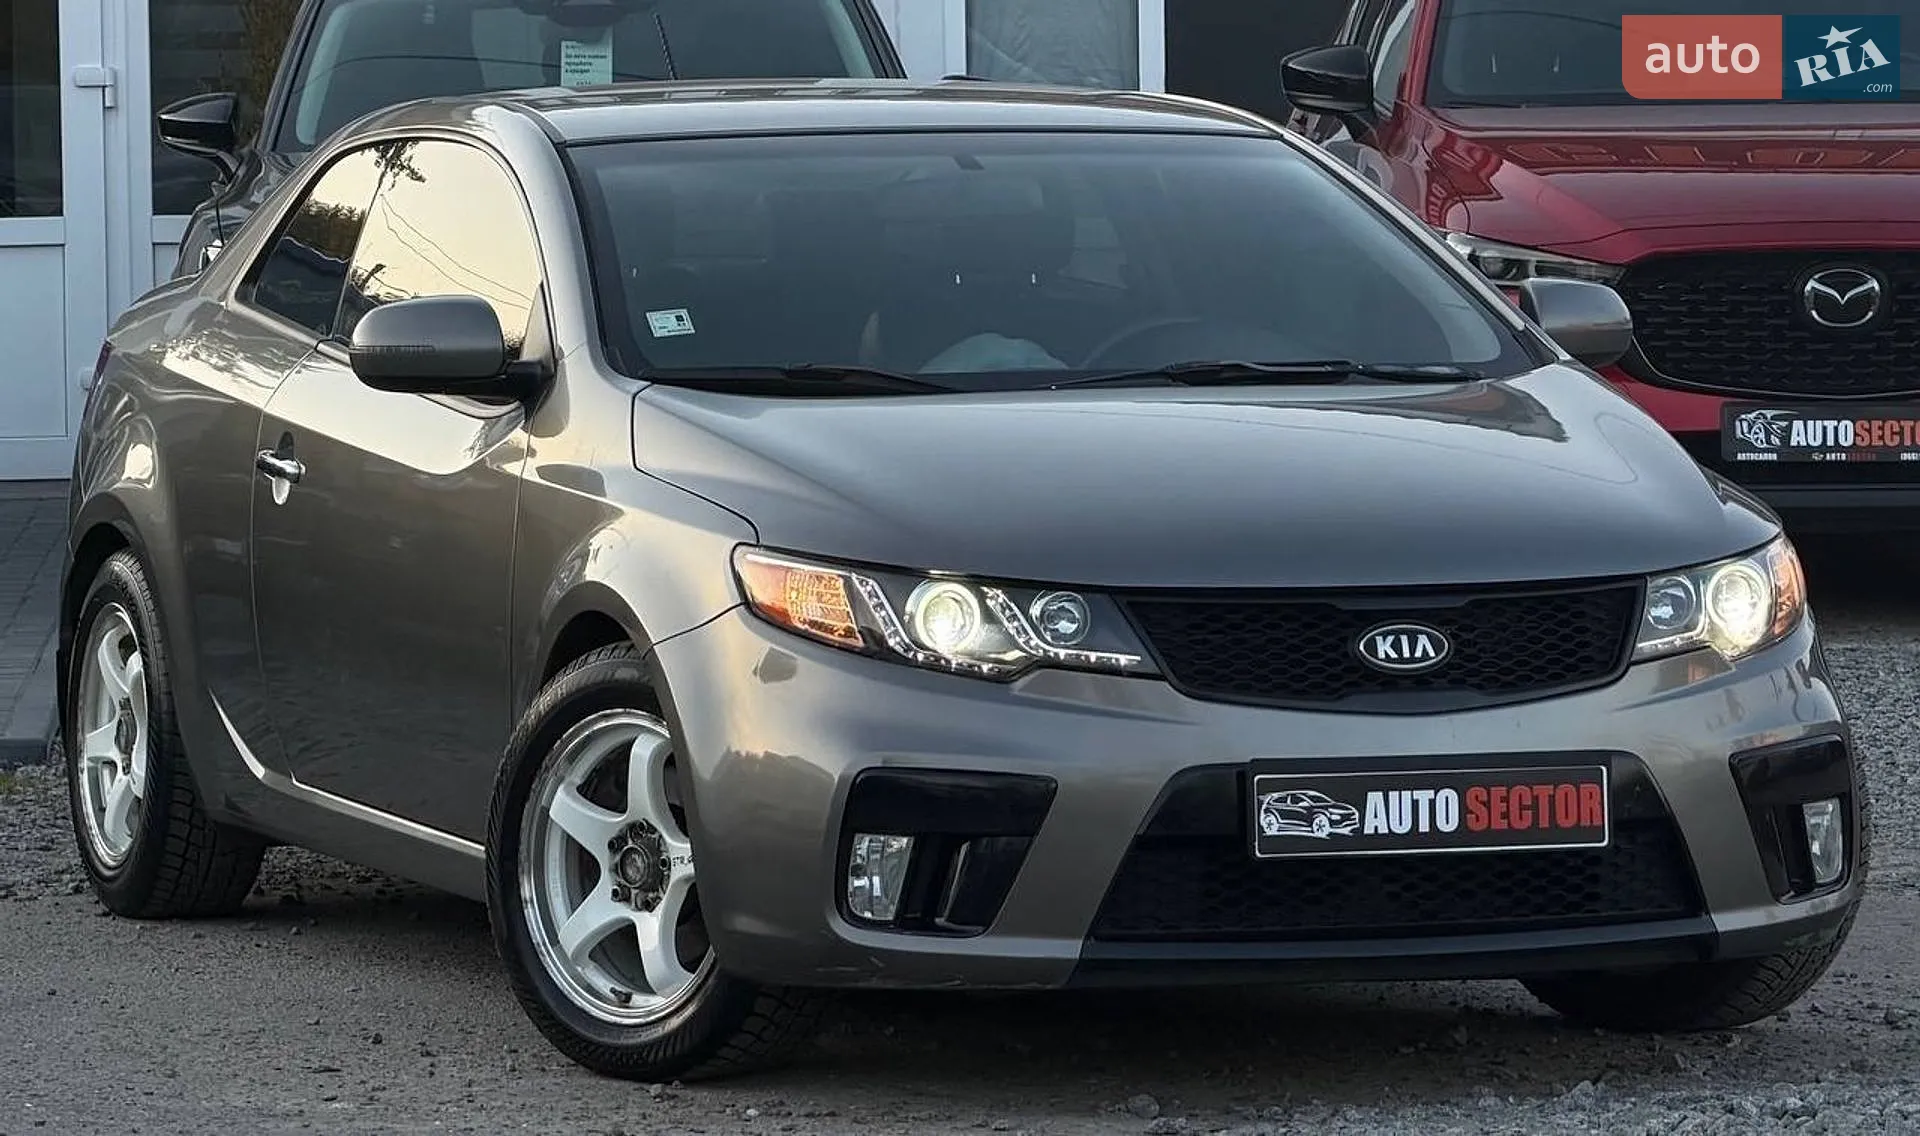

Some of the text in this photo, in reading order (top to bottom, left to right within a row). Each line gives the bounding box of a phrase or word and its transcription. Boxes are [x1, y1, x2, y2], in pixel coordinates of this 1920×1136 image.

[1375, 634, 1436, 660] KIA
[1363, 782, 1603, 836] AUTO SECTOR
